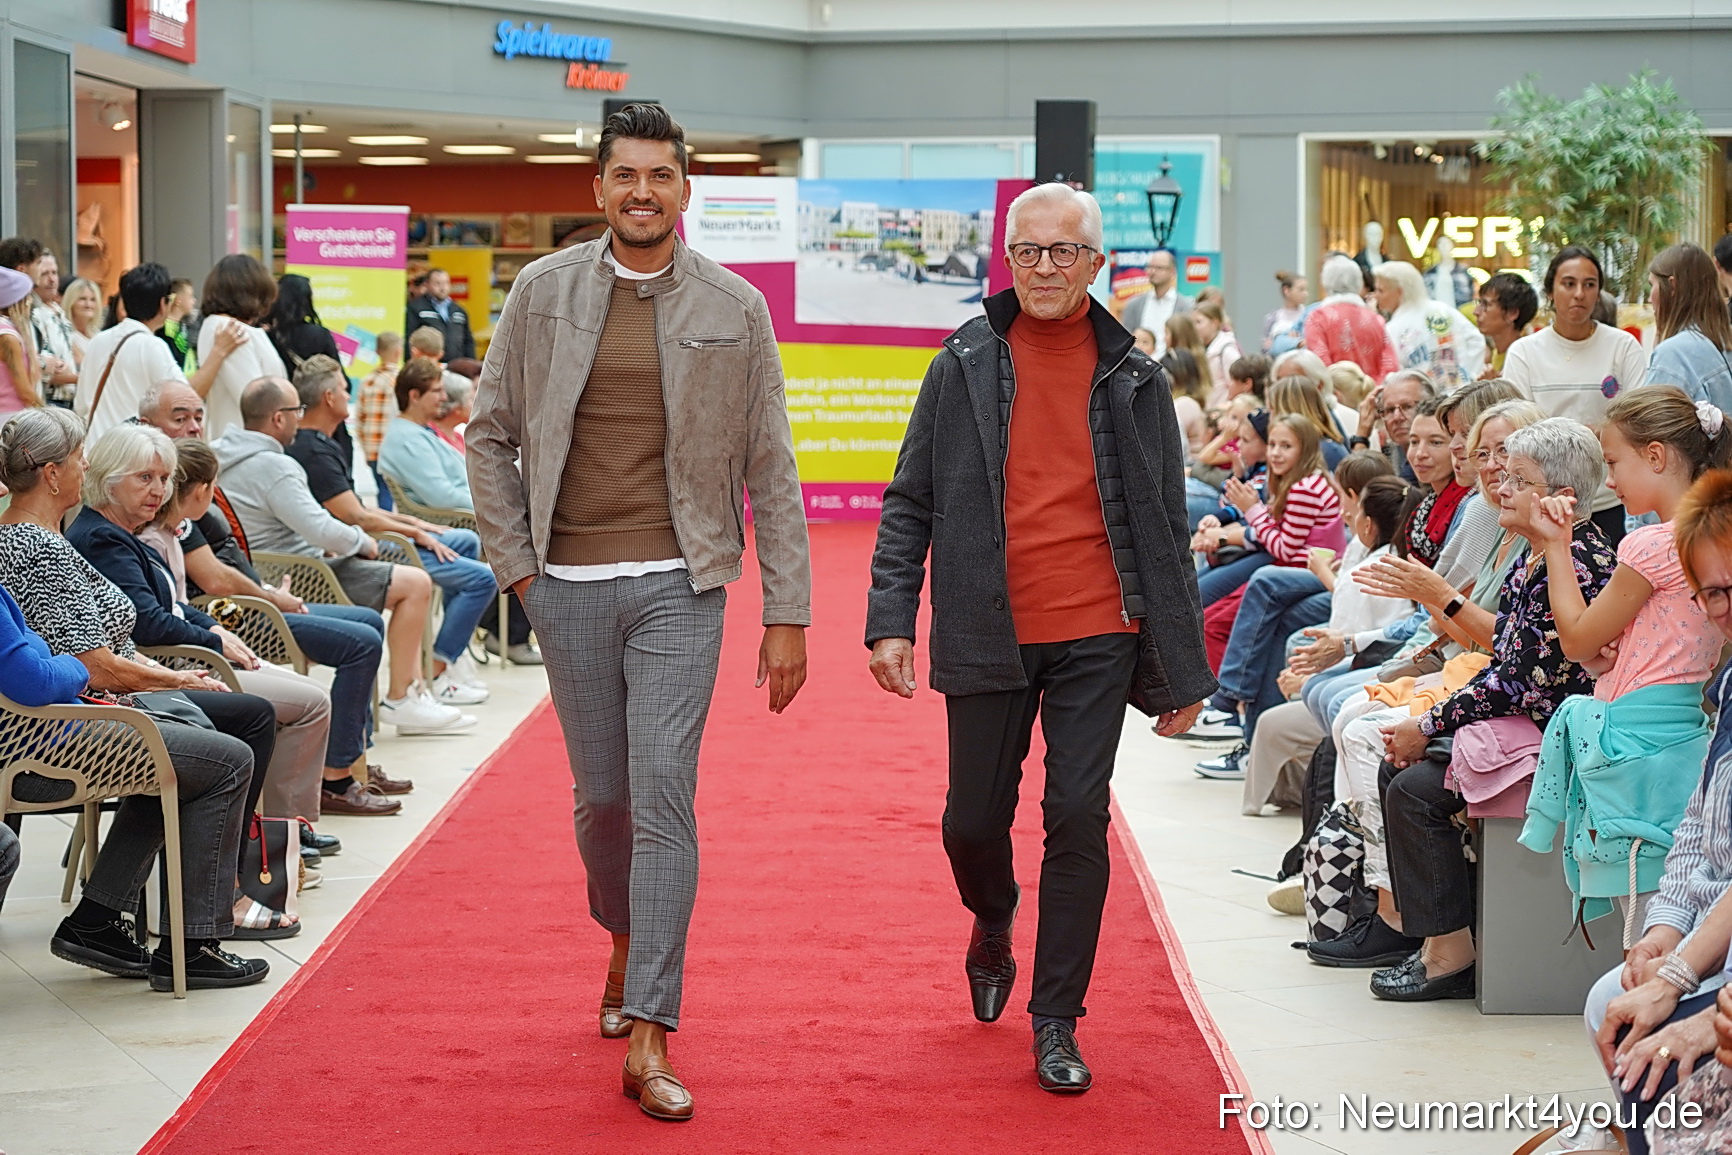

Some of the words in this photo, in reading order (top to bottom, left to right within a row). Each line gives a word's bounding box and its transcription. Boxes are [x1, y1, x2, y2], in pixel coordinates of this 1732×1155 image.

[494, 19, 612, 62] Spielwaren
[566, 61, 629, 91] Krämer
[293, 226, 375, 243] Verschenken
[375, 227, 397, 243] Sie
[1398, 215, 1545, 258] VER
[319, 241, 396, 259] Gutscheine!
[1186, 263, 1210, 277] LEGO
[831, 376, 865, 391] nicht
[851, 392, 907, 407] Workout
[814, 409, 895, 423] Traumurlaub
[828, 437, 849, 452] Du
